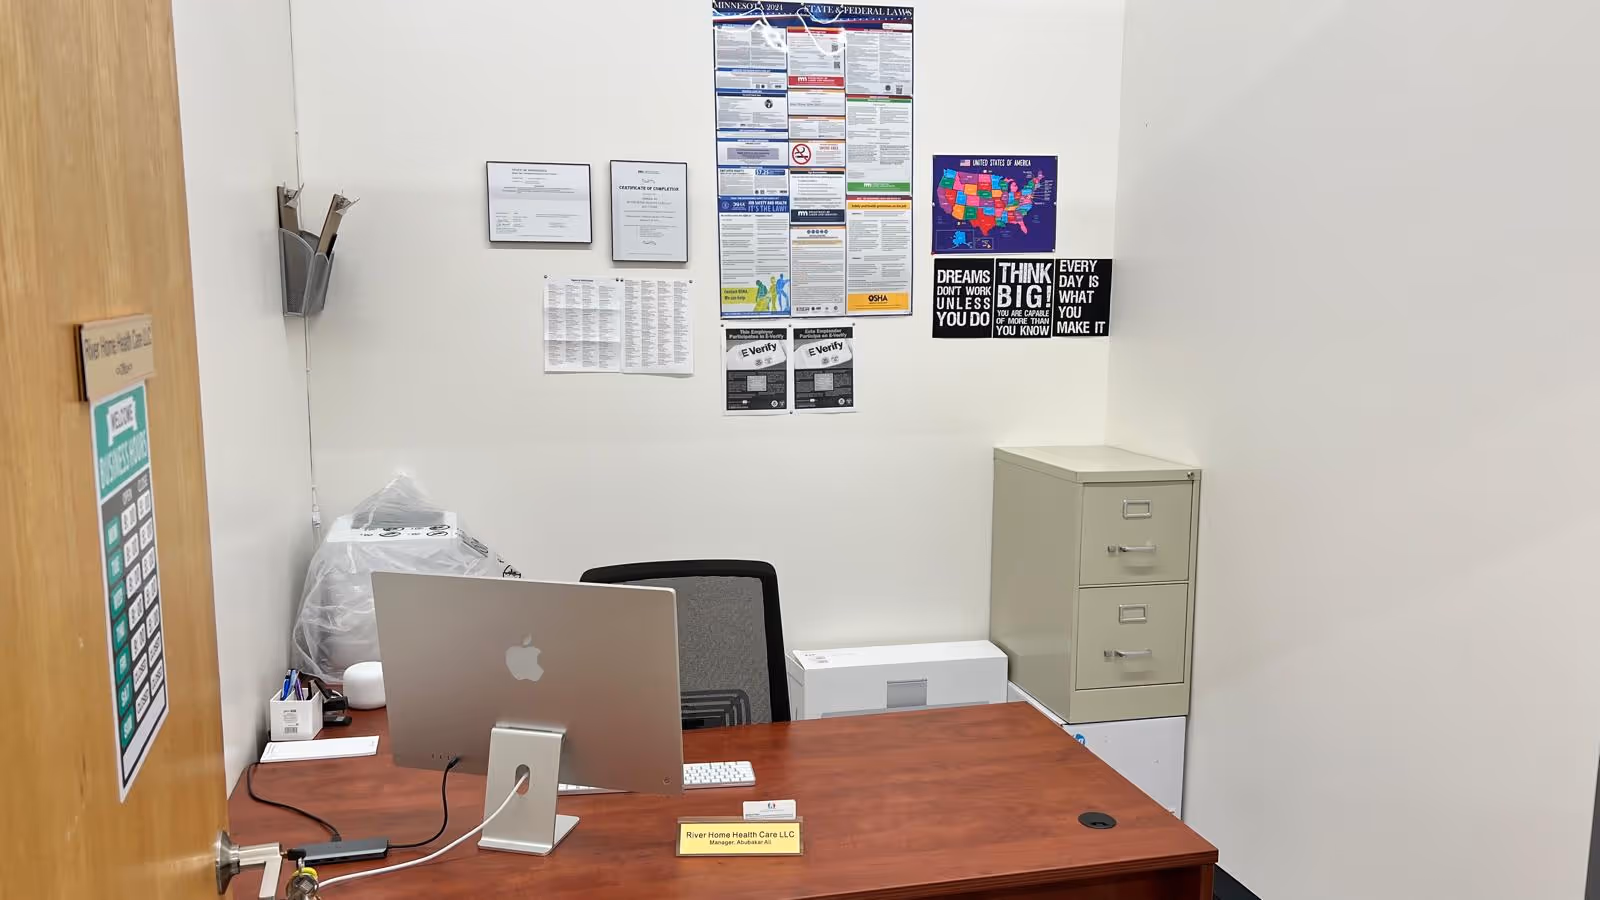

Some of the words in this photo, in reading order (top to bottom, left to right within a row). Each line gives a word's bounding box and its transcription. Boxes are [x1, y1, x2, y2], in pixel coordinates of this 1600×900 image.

[713, 1, 764, 11] MINNESOTA
[844, 6, 885, 15] FEDERAL
[886, 8, 912, 16] LAWS
[1059, 259, 1098, 273] EVERY
[937, 269, 991, 284] DREAMS
[999, 262, 1052, 284] THINK
[1059, 275, 1084, 288] DAY
[1088, 275, 1099, 288] IS
[937, 286, 961, 296] DON'T
[965, 286, 991, 296] WORK
[997, 284, 1052, 308] BIG!
[1059, 290, 1095, 304] WHAT
[868, 294, 888, 302] OSHA
[937, 297, 991, 310] UNLESS
[937, 311, 966, 327] YOU
[969, 311, 990, 327] DO
[997, 309, 1009, 317] YOU
[1011, 309, 1022, 317] ARE
[1024, 309, 1049, 317] CAPABLE
[1058, 306, 1082, 319] YOU
[996, 317, 1005, 325] OF
[1008, 317, 1027, 325] MORE
[1031, 317, 1049, 325] THAN
[1057, 321, 1090, 334] MAKE
[1094, 321, 1106, 334] IT
[996, 325, 1016, 336] YOU
[1020, 325, 1049, 336] KNOW
[741, 348, 749, 358] E
[748, 342, 777, 355] Verify
[808, 347, 816, 357] E
[815, 341, 843, 354] Verify
[686, 831, 707, 839] River
[708, 831, 731, 839] Home
[732, 831, 757, 839] Health
[759, 830, 778, 839] Care
[779, 830, 795, 838] LLC
